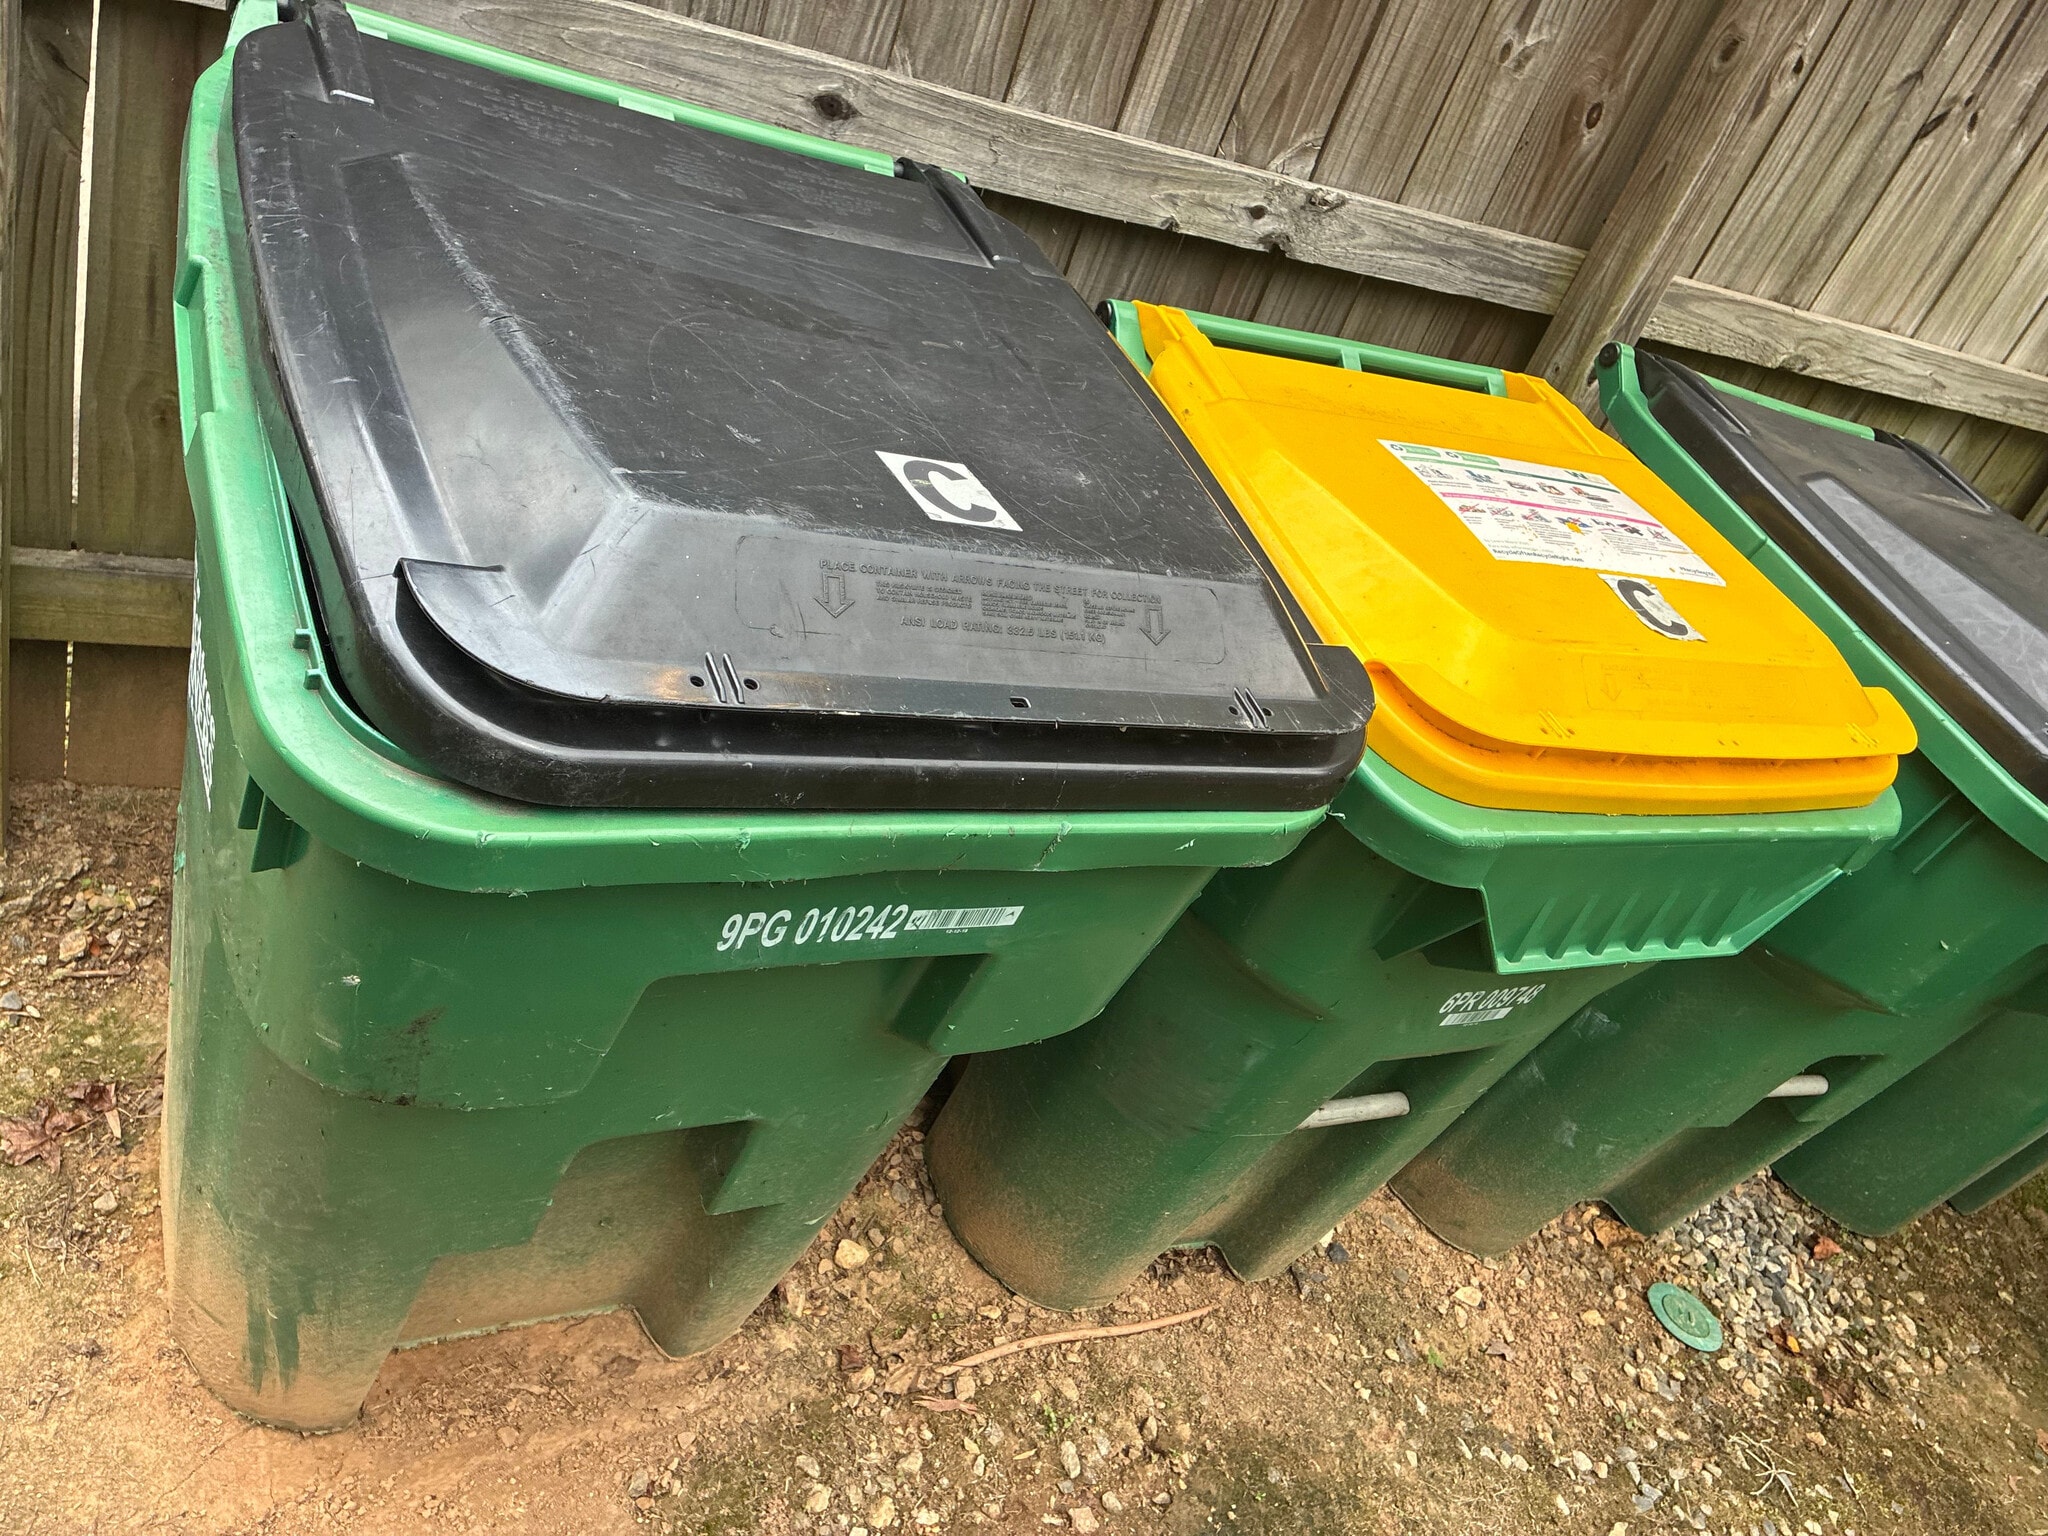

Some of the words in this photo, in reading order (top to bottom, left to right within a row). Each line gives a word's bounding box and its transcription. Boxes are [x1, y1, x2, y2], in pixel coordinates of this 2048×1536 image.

[903, 460, 997, 522] C
[820, 560, 856, 572] PLACE
[859, 563, 918, 579] CONTAINER
[921, 569, 948, 582] WITH
[952, 575, 993, 586] ARROWS
[997, 579, 1031, 591] FACING
[1033, 583, 1051, 593] THE
[1054, 585, 1088, 596] STREET
[1091, 589, 1108, 599] FOR
[1110, 591, 1162, 604] COLLECTION
[900, 616, 926, 627] ANSI
[930, 618, 958, 630] LOAD
[962, 621, 1003, 634] RATING:
[1038, 628, 1057, 639] LBS
[1617, 579, 1688, 636] C
[717, 909, 792, 951] 9PG
[794, 904, 909, 945] 010242
[1439, 990, 1486, 1013] 6PR
